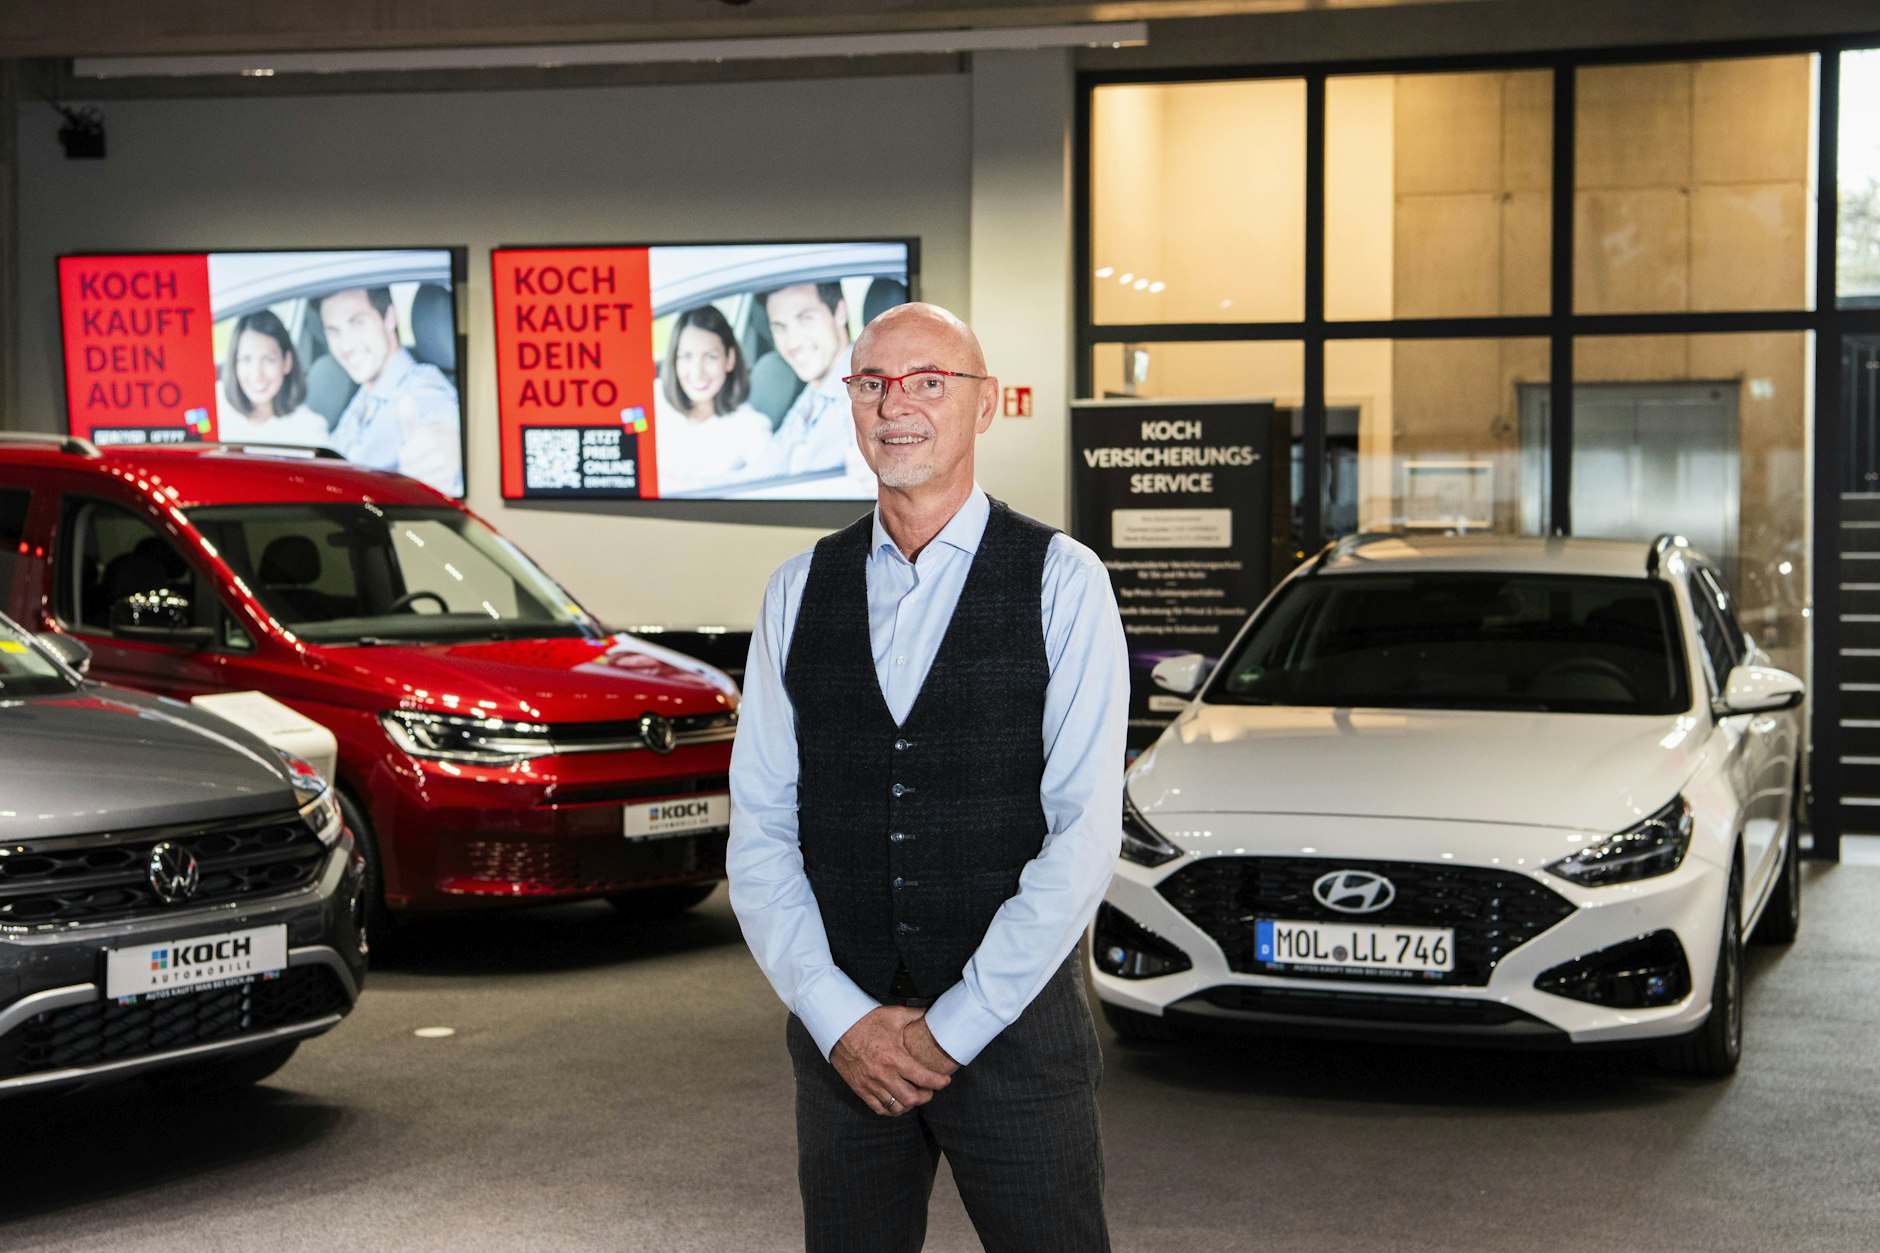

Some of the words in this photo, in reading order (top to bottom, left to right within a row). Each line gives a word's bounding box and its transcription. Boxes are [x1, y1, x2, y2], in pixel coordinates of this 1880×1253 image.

[81, 272, 176, 300] KOCH
[514, 266, 616, 295] KOCH
[83, 308, 195, 337] KAUFT
[516, 303, 633, 333] KAUFT
[86, 346, 165, 373] DEIN
[518, 342, 601, 370] DEIN
[88, 382, 181, 409] AUTO
[518, 378, 618, 408] AUTO
[1141, 420, 1202, 441] KOCH
[1083, 446, 1261, 468] VERSICHERUNGS-
[1130, 473, 1213, 493] SERVICE
[662, 802, 708, 819] KOCH
[173, 937, 251, 967] KOCH
[1277, 928, 1328, 959] MOL
[1353, 932, 1386, 963] LL
[1396, 934, 1448, 966] 746
[151, 961, 252, 985] AUTOMOBILE
[145, 989, 170, 1001] AUTOS
[171, 985, 194, 996] KAUFT
[195, 983, 212, 992] MAN
[213, 980, 225, 989] BEI
